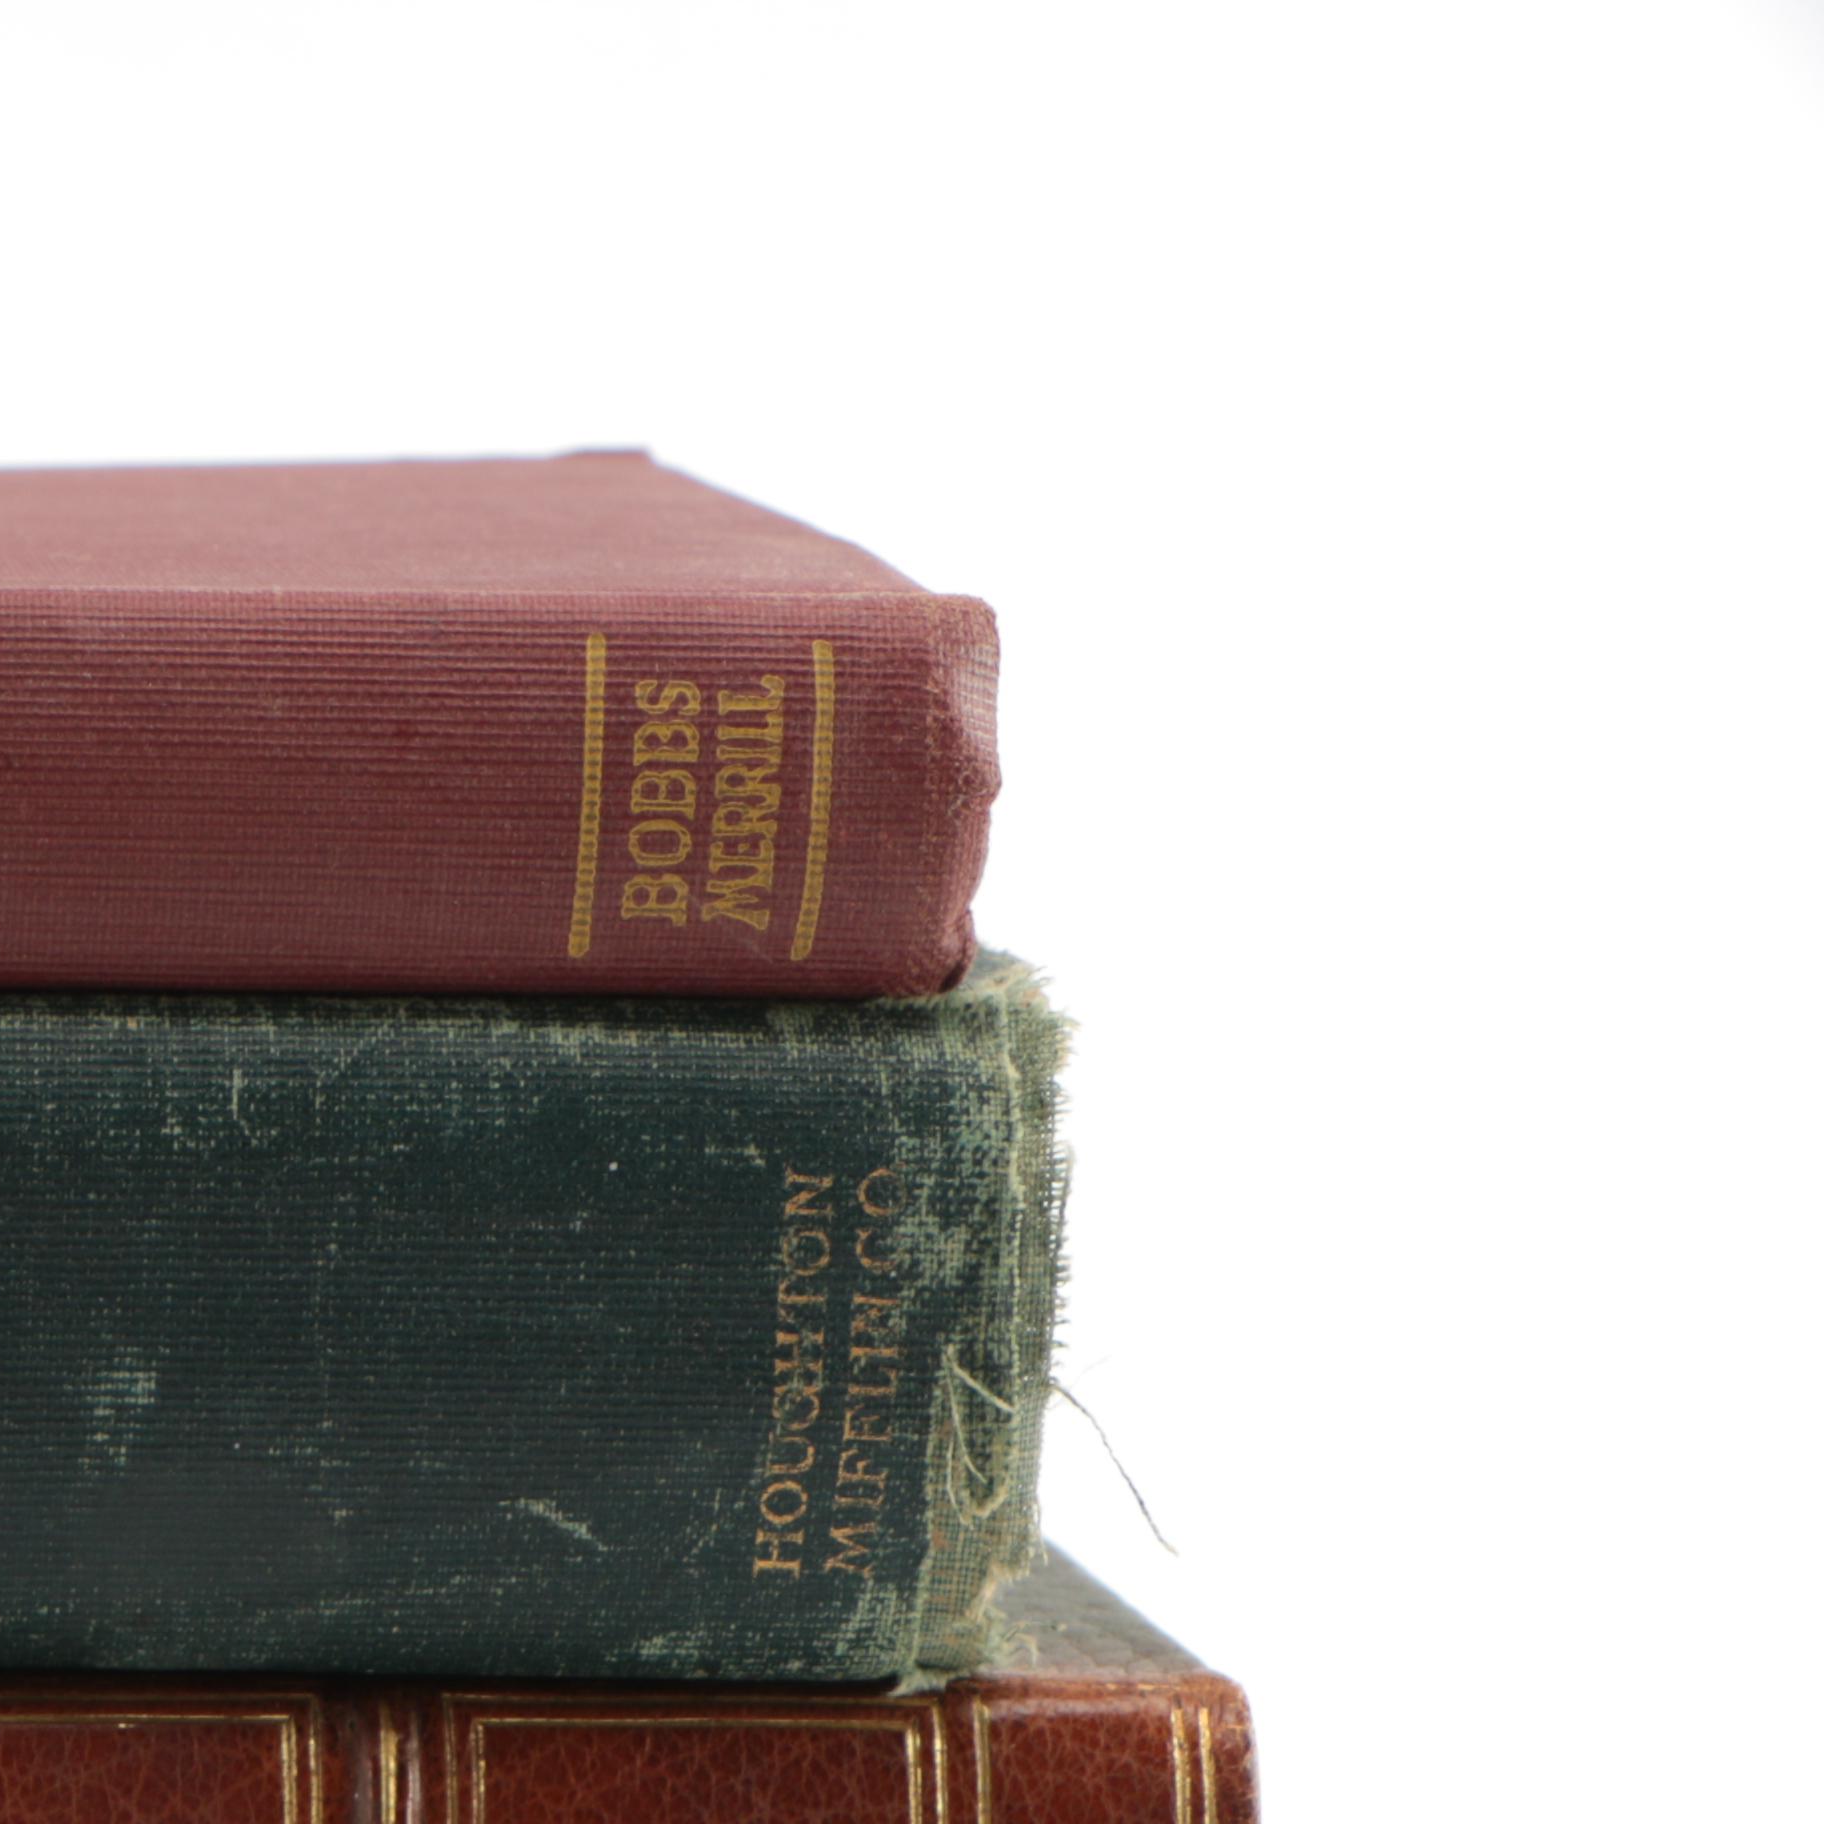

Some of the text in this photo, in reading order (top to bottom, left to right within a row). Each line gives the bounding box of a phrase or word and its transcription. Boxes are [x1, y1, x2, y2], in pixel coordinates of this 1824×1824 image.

[621, 680, 701, 926] BOBBS
[703, 675, 784, 930] MERRILL
[752, 1162, 834, 1579] HOUGHTON
[824, 1293, 902, 1578] MIFFLIN
